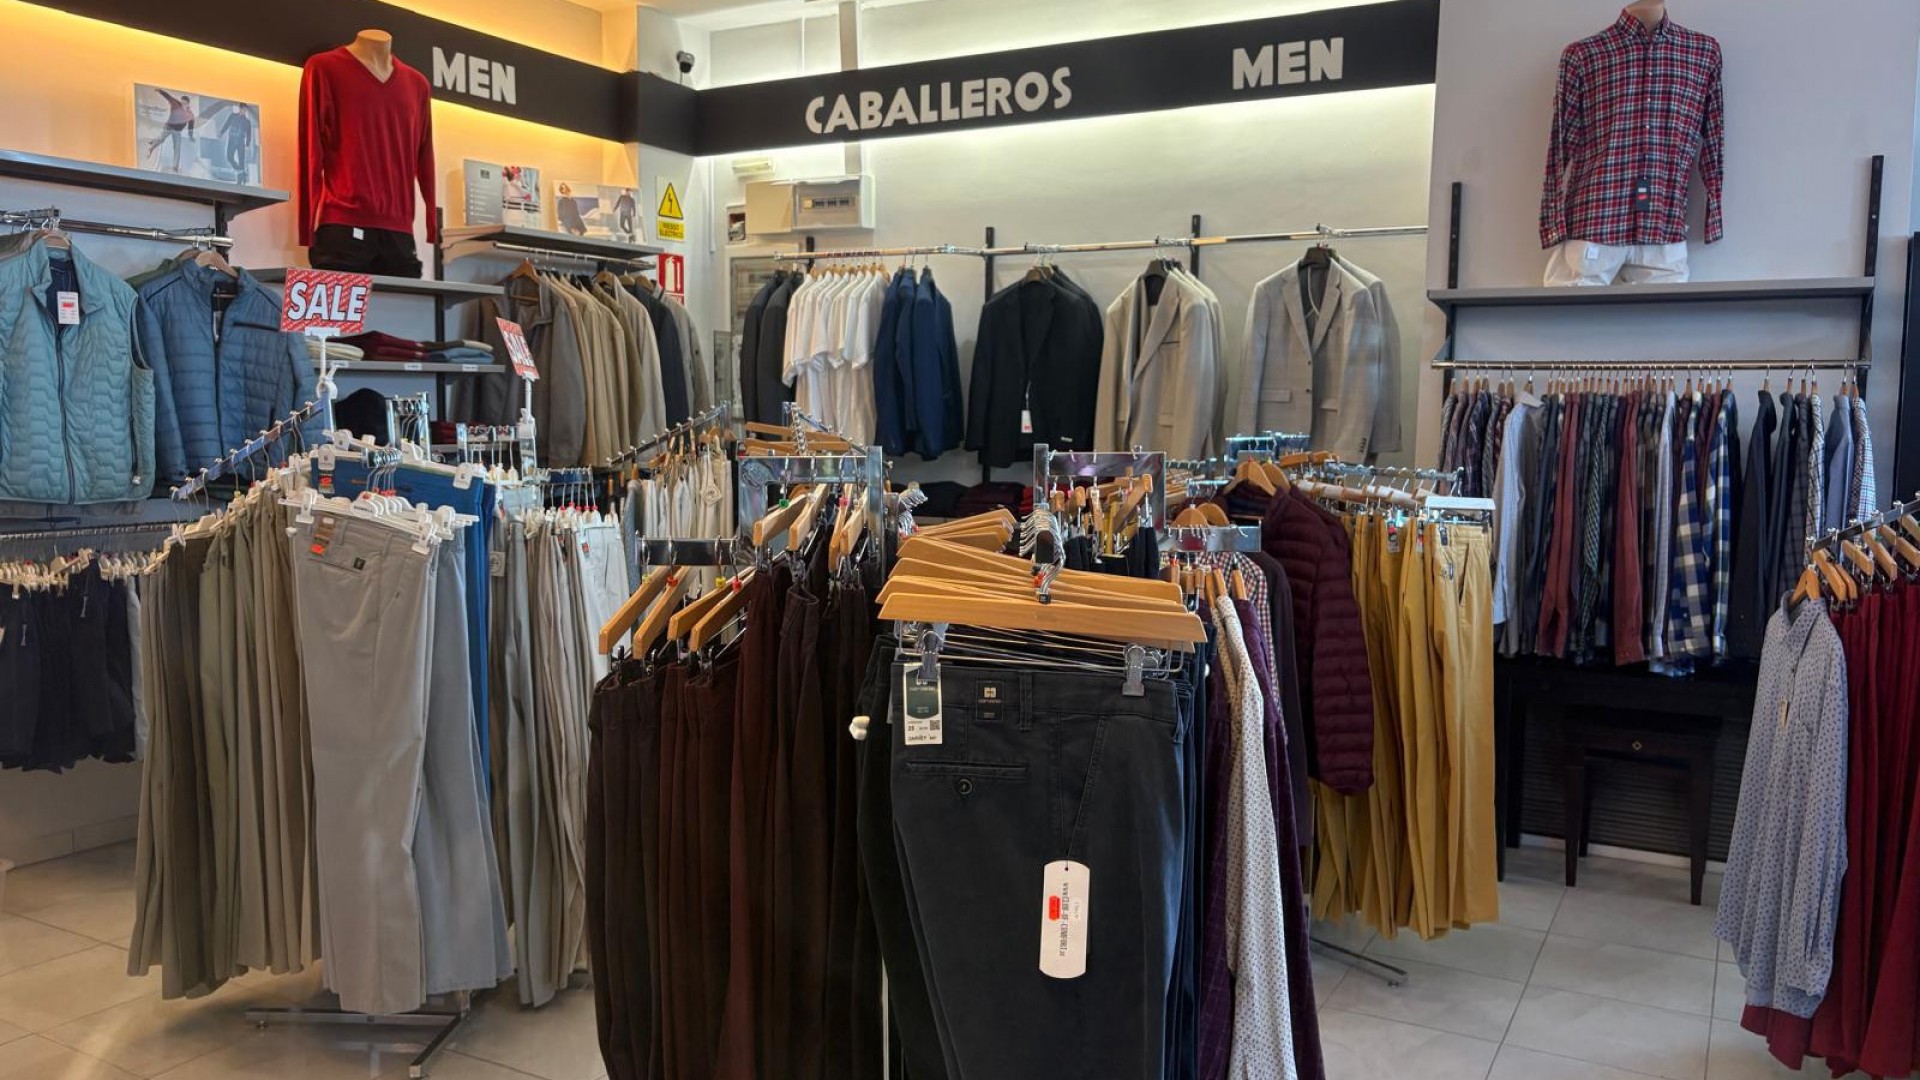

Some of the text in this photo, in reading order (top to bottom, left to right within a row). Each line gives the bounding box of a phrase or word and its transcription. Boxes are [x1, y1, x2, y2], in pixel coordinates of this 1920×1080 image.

[432, 46, 516, 105] MEN
[1232, 37, 1344, 90] MEN
[805, 66, 1072, 134] CABALLEROS
[287, 280, 367, 322] SALE
[502, 330, 535, 368] SALE
